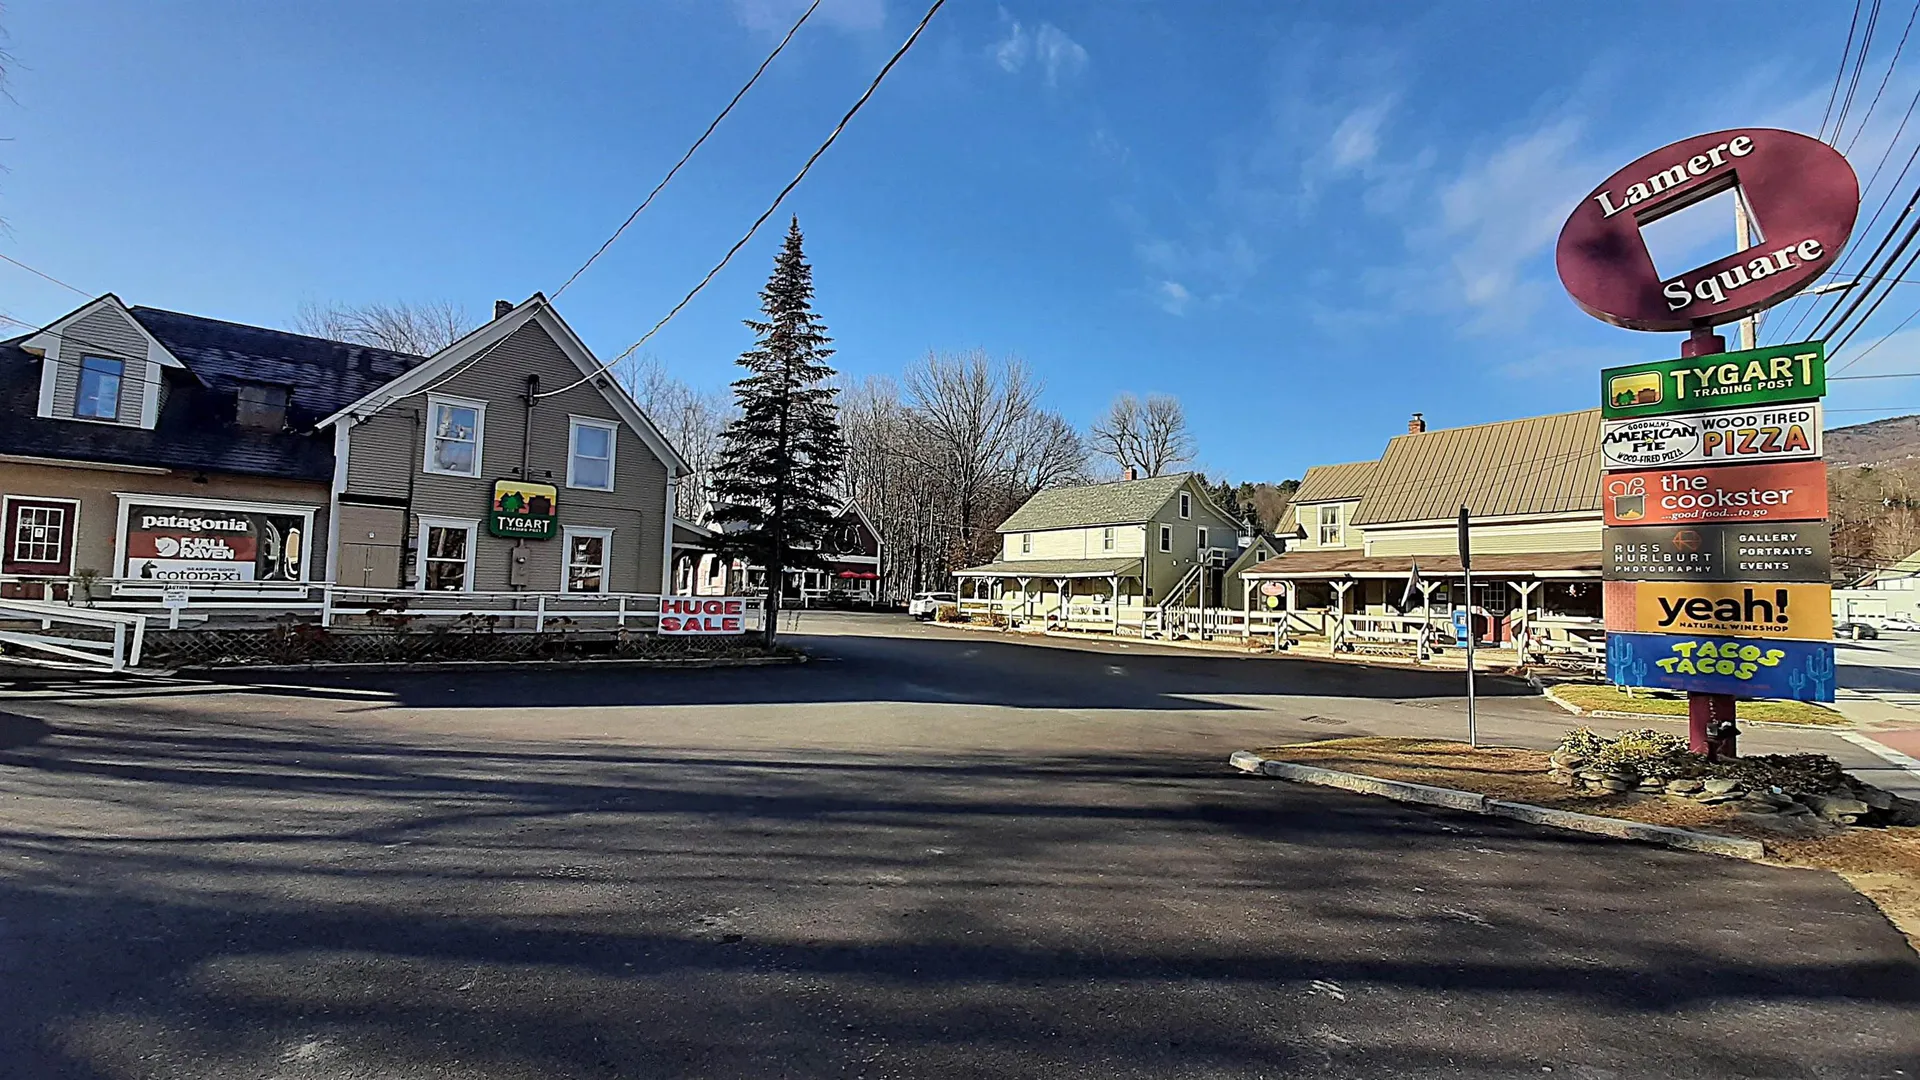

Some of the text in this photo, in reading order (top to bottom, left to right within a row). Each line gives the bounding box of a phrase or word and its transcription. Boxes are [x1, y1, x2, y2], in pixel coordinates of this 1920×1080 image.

[1594, 134, 1754, 218] Lamere
[1663, 238, 1823, 311] Square
[1670, 353, 1817, 399] TYGART
[1693, 379, 1794, 398] TRADING POST
[1628, 422, 1670, 430] GOODMANS
[1702, 411, 1810, 429] WOOD FIRED
[1602, 426, 1697, 445] AMERICAN
[1703, 425, 1810, 457] PIZZA
[1633, 441, 1666, 453] PIE
[1617, 448, 1684, 463] WOOD-FIRED PIZZA
[1660, 474, 1708, 492] the
[1661, 488, 1794, 510] cookster
[1753, 508, 1768, 518] go
[141, 515, 248, 532] patagonia
[497, 516, 551, 533] TYGART
[1739, 533, 1798, 543] GALLERY
[180, 548, 235, 560] RAVEN
[1614, 544, 1661, 553] RUSS
[1739, 547, 1813, 556] PORTRAITS
[1614, 553, 1713, 563] HURLBURT
[1615, 565, 1712, 573] PHOTOGRAPHY
[1739, 562, 1790, 571] EVENTS
[661, 600, 743, 615] HUGE
[1657, 588, 1789, 627] yeah!
[660, 617, 740, 631] SALE
[1679, 622, 1789, 632] NATURAL WINESHOP
[1672, 640, 1786, 668] TACOS
[1655, 656, 1759, 680] TACOS
